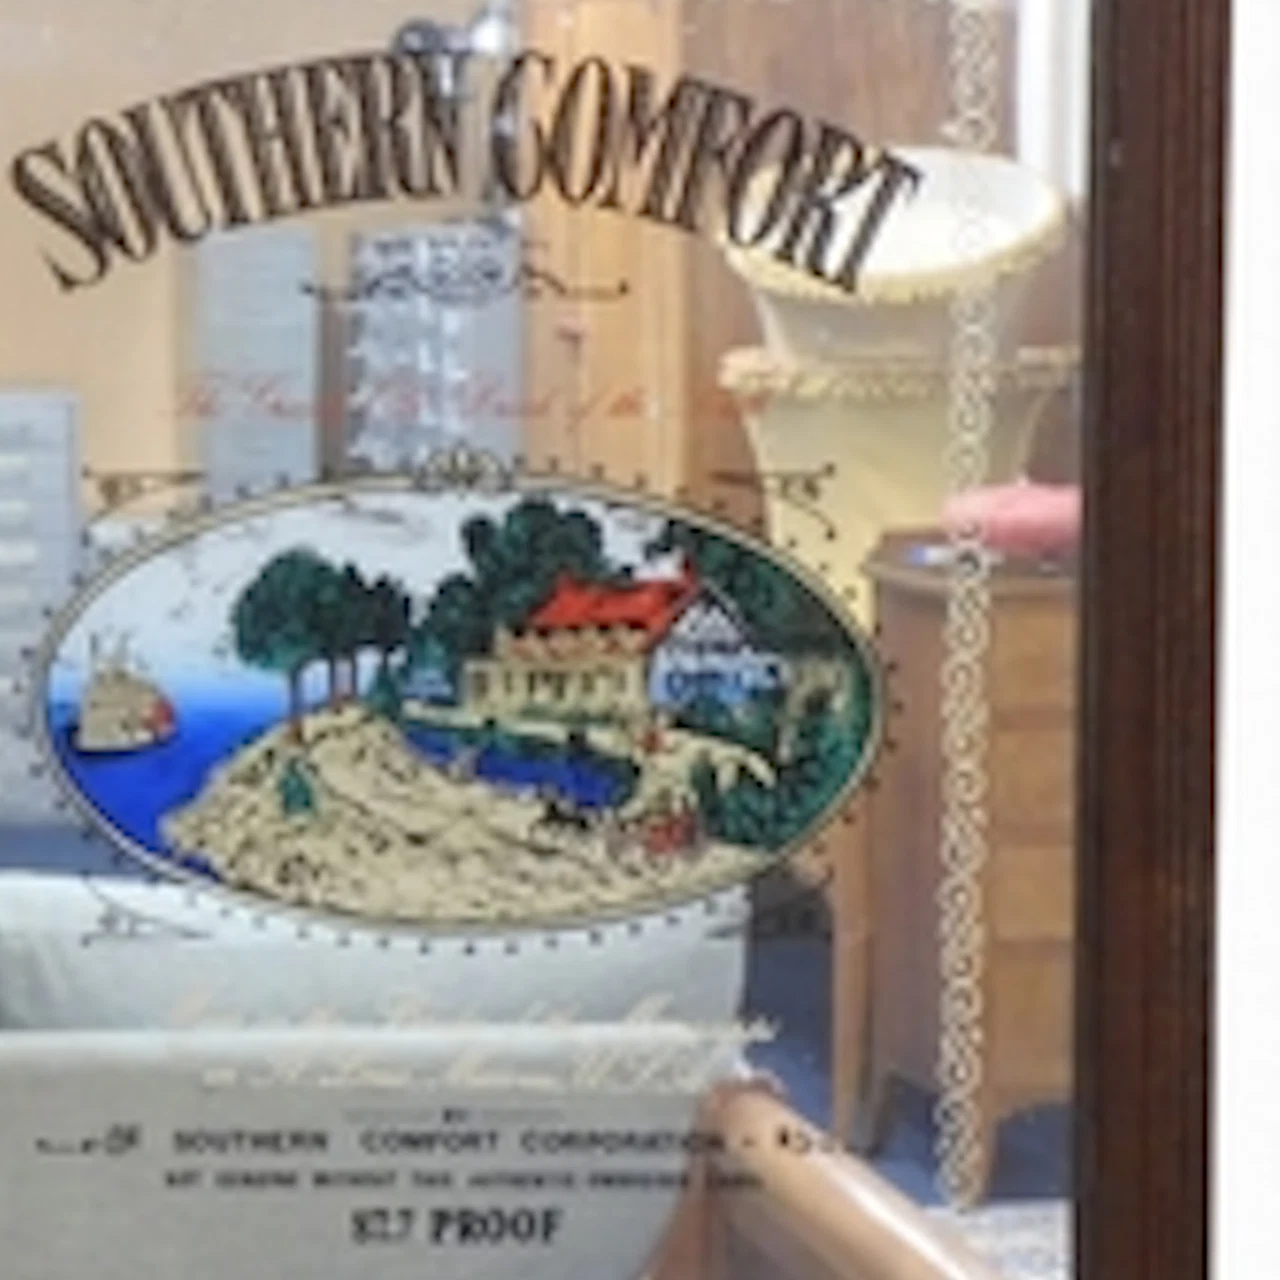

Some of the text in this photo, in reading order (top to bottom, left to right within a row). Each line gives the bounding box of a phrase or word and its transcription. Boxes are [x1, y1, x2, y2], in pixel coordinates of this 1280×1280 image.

[9, 50, 921, 293] SOUTHERN COMFORT
[173, 1129, 726, 1156] SOUTHERN COMFORT CORPORATION
[430, 1206, 564, 1246] PROOF
